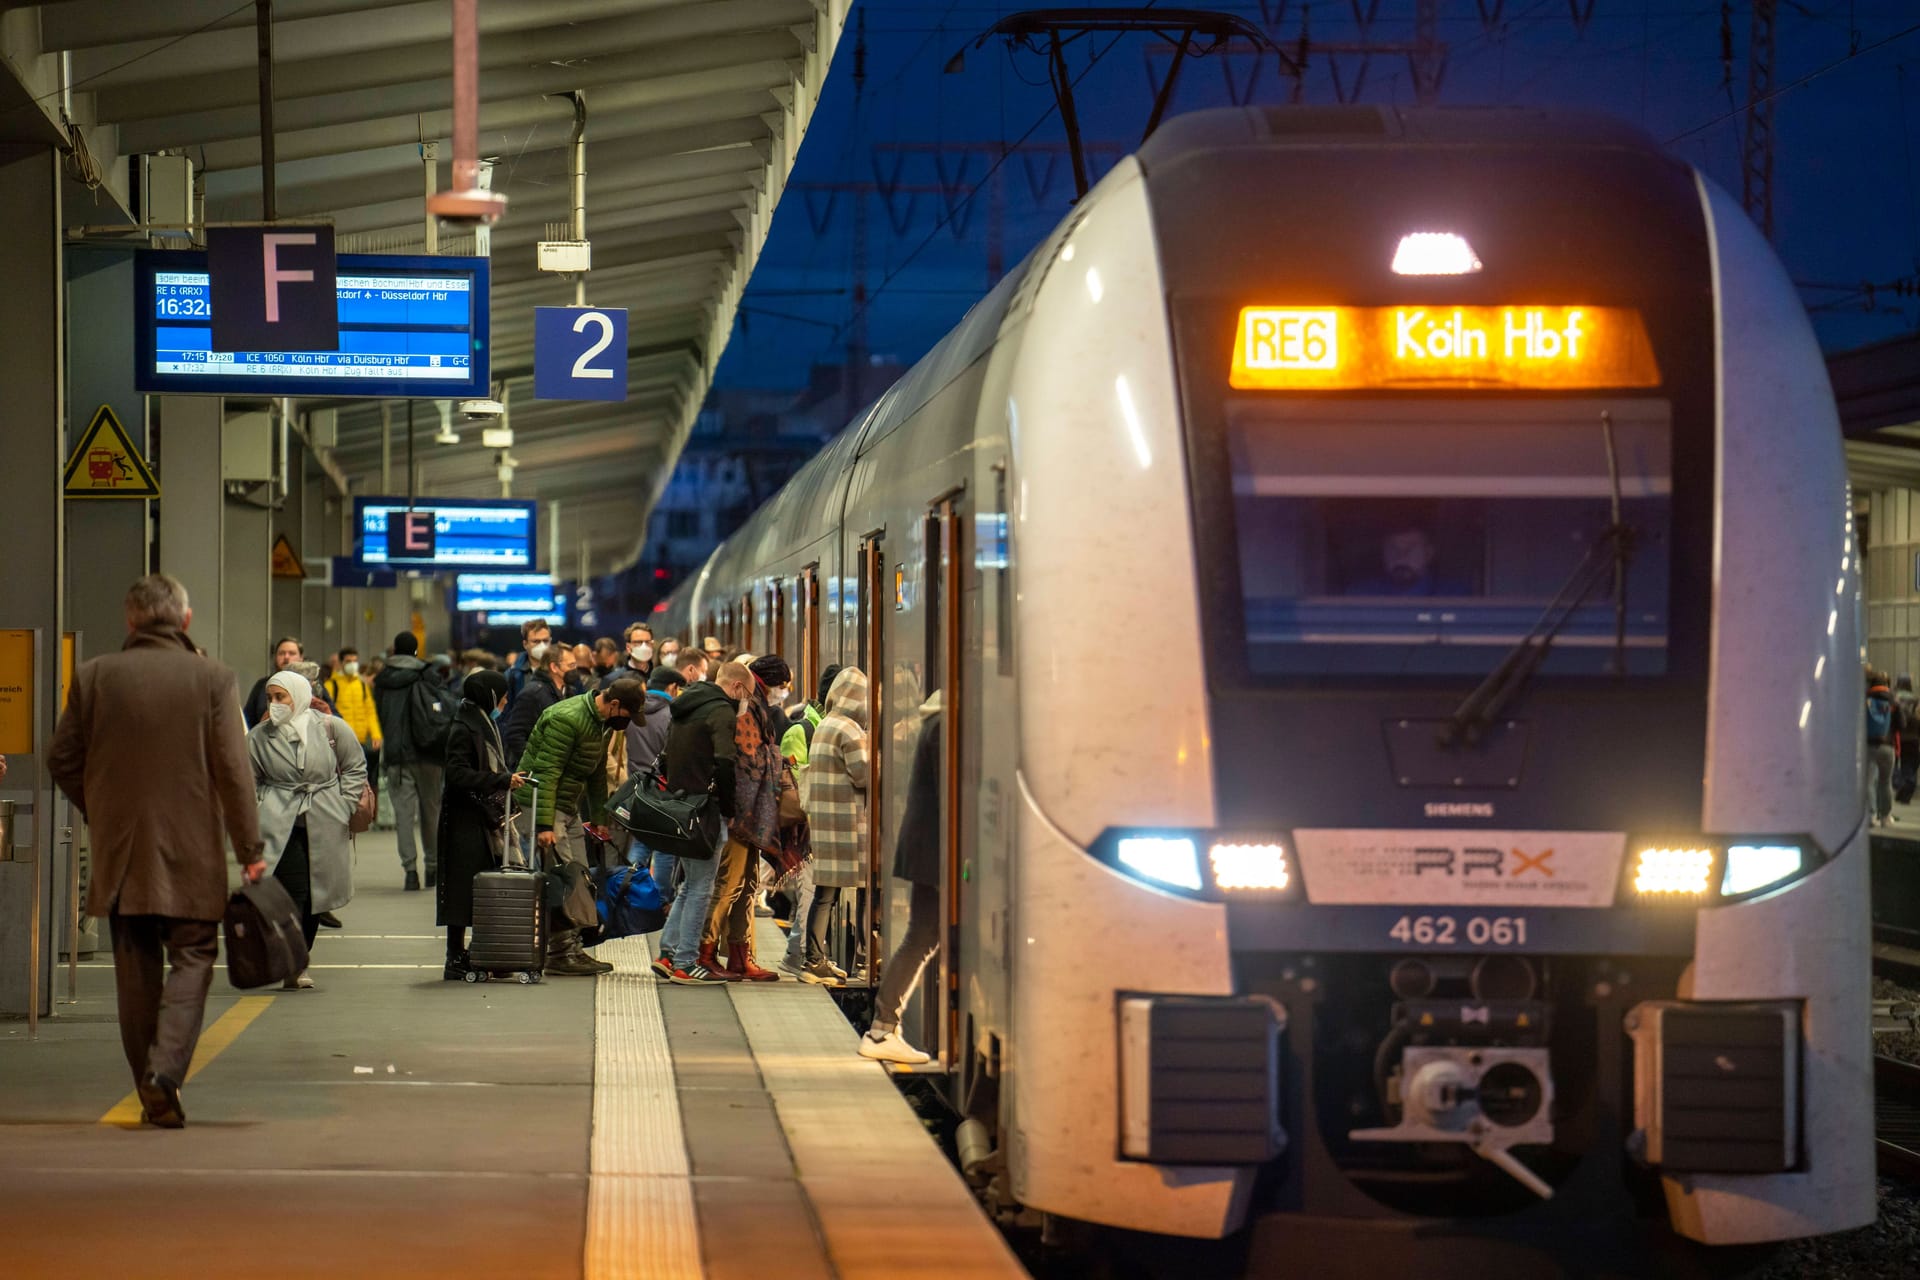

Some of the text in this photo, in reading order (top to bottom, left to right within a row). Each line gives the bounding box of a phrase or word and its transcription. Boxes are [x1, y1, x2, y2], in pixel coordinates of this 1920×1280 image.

[263, 233, 316, 322] F
[156, 286, 168, 295] RE
[170, 287, 177, 295] 6
[179, 287, 203, 296] (RRX)
[381, 290, 429, 301] Düsseldorf
[432, 291, 448, 302] Hbf
[157, 298, 205, 316] 16:32
[571, 311, 614, 380] 2
[1251, 311, 1583, 362] RE6 Köln Hbf
[181, 352, 205, 362] 17:15
[208, 353, 233, 362] 17:20
[246, 353, 260, 363] ICE
[263, 354, 285, 363] 1050
[291, 353, 312, 364] Köln
[314, 355, 329, 364] Hbf
[337, 355, 351, 364] via
[353, 356, 392, 367] Duisburg
[394, 356, 410, 366] Hbf
[405, 512, 429, 550] E
[1424, 802, 1494, 817] SIEMENS
[1413, 847, 1555, 878] RRX
[1389, 915, 1527, 946] 462 061
